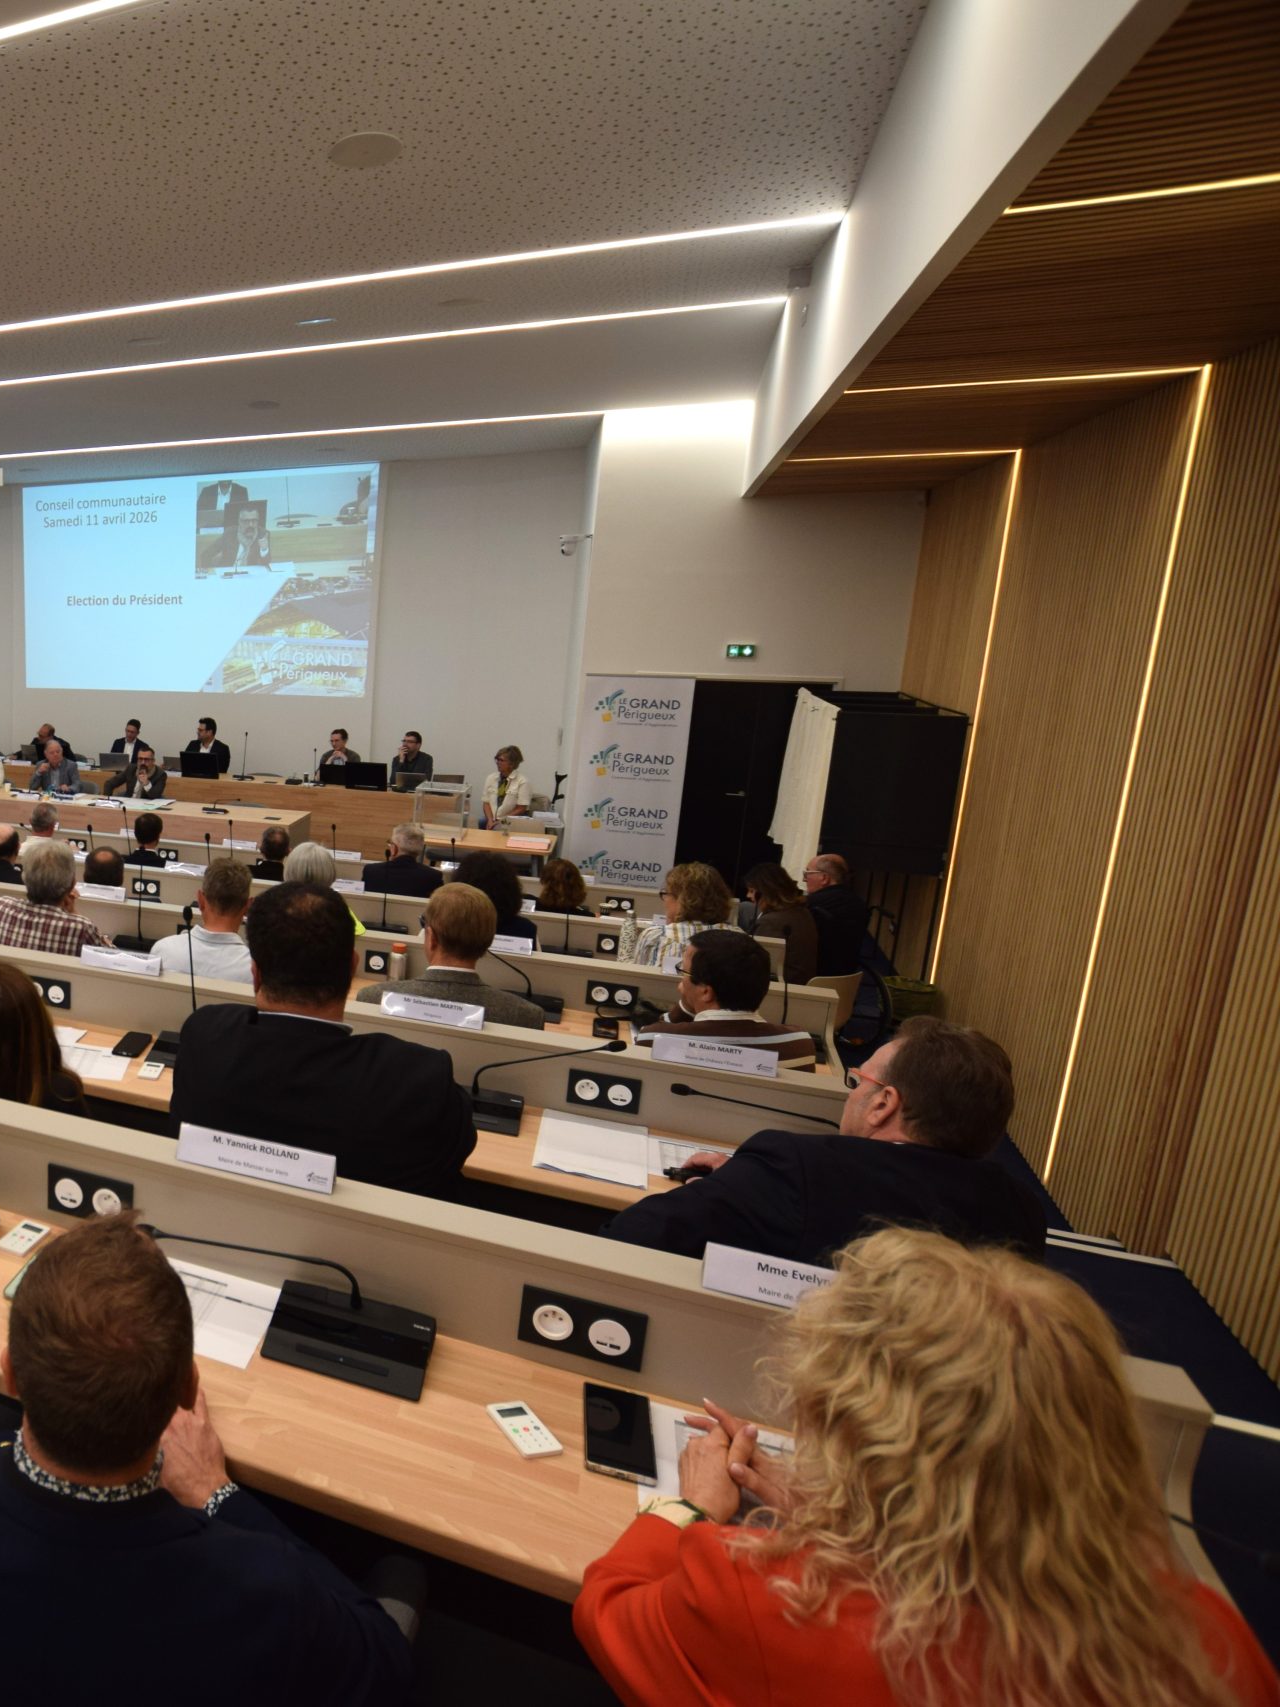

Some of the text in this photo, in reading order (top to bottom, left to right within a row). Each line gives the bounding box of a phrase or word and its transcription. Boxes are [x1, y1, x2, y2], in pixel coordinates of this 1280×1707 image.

[35, 493, 167, 512] Conseil communautaire
[43, 510, 158, 528] Samedi 11 avril 2026
[66, 593, 183, 606] Election du Président
[292, 650, 353, 667] GRAND
[629, 698, 681, 710] GRAND
[617, 705, 676, 722] Périgueux
[623, 752, 675, 766] GRAND
[612, 760, 670, 776] Périgueux
[618, 806, 669, 820] GRAND
[606, 813, 663, 831] Périgueux
[612, 859, 662, 873] GRAND
[600, 866, 657, 883] Périgueux
[688, 1041, 743, 1055] M. Alain MARTY
[213, 1135, 300, 1161] M. Yannick ROLLAND
[757, 1262, 789, 1277] Mme
[758, 1286, 782, 1298] Maire
[783, 1292, 794, 1300] de
